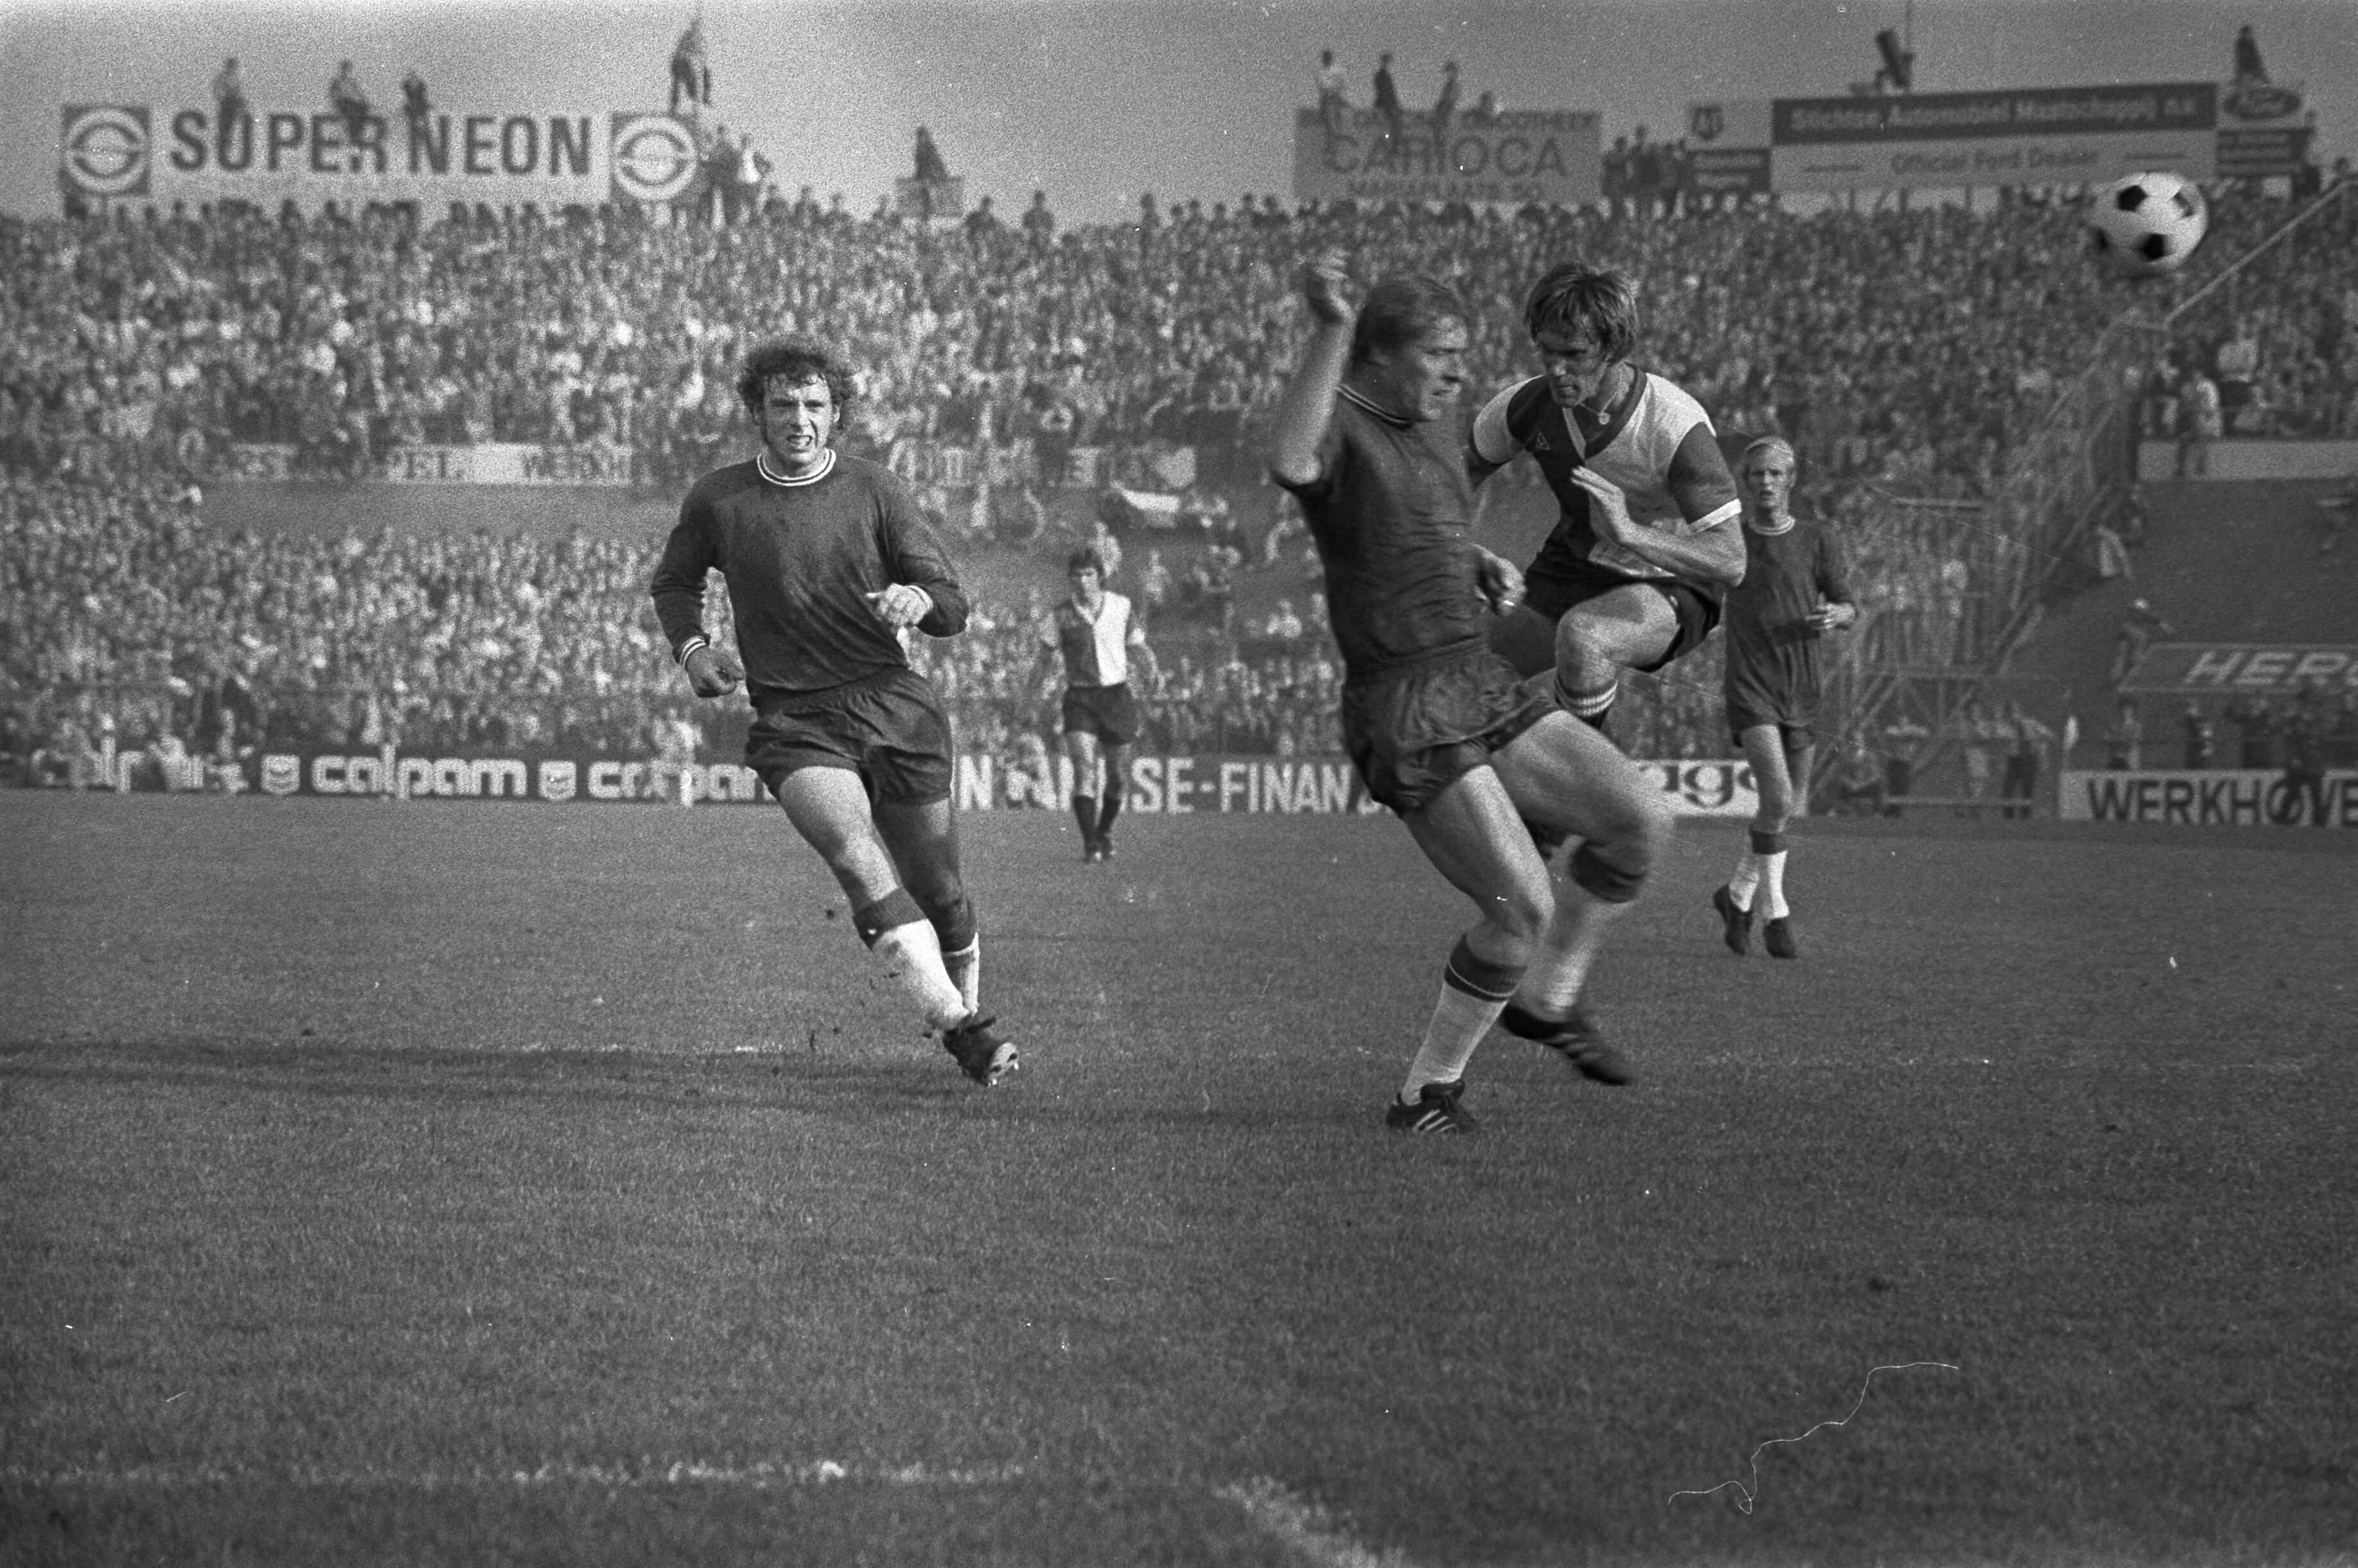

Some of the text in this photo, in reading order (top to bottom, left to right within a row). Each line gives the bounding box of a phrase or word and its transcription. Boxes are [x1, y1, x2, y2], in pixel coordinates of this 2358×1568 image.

[170, 110, 592, 177] SUPER NEON
[1323, 134, 1568, 178] CARIOCA
[312, 744, 528, 800] calpam
